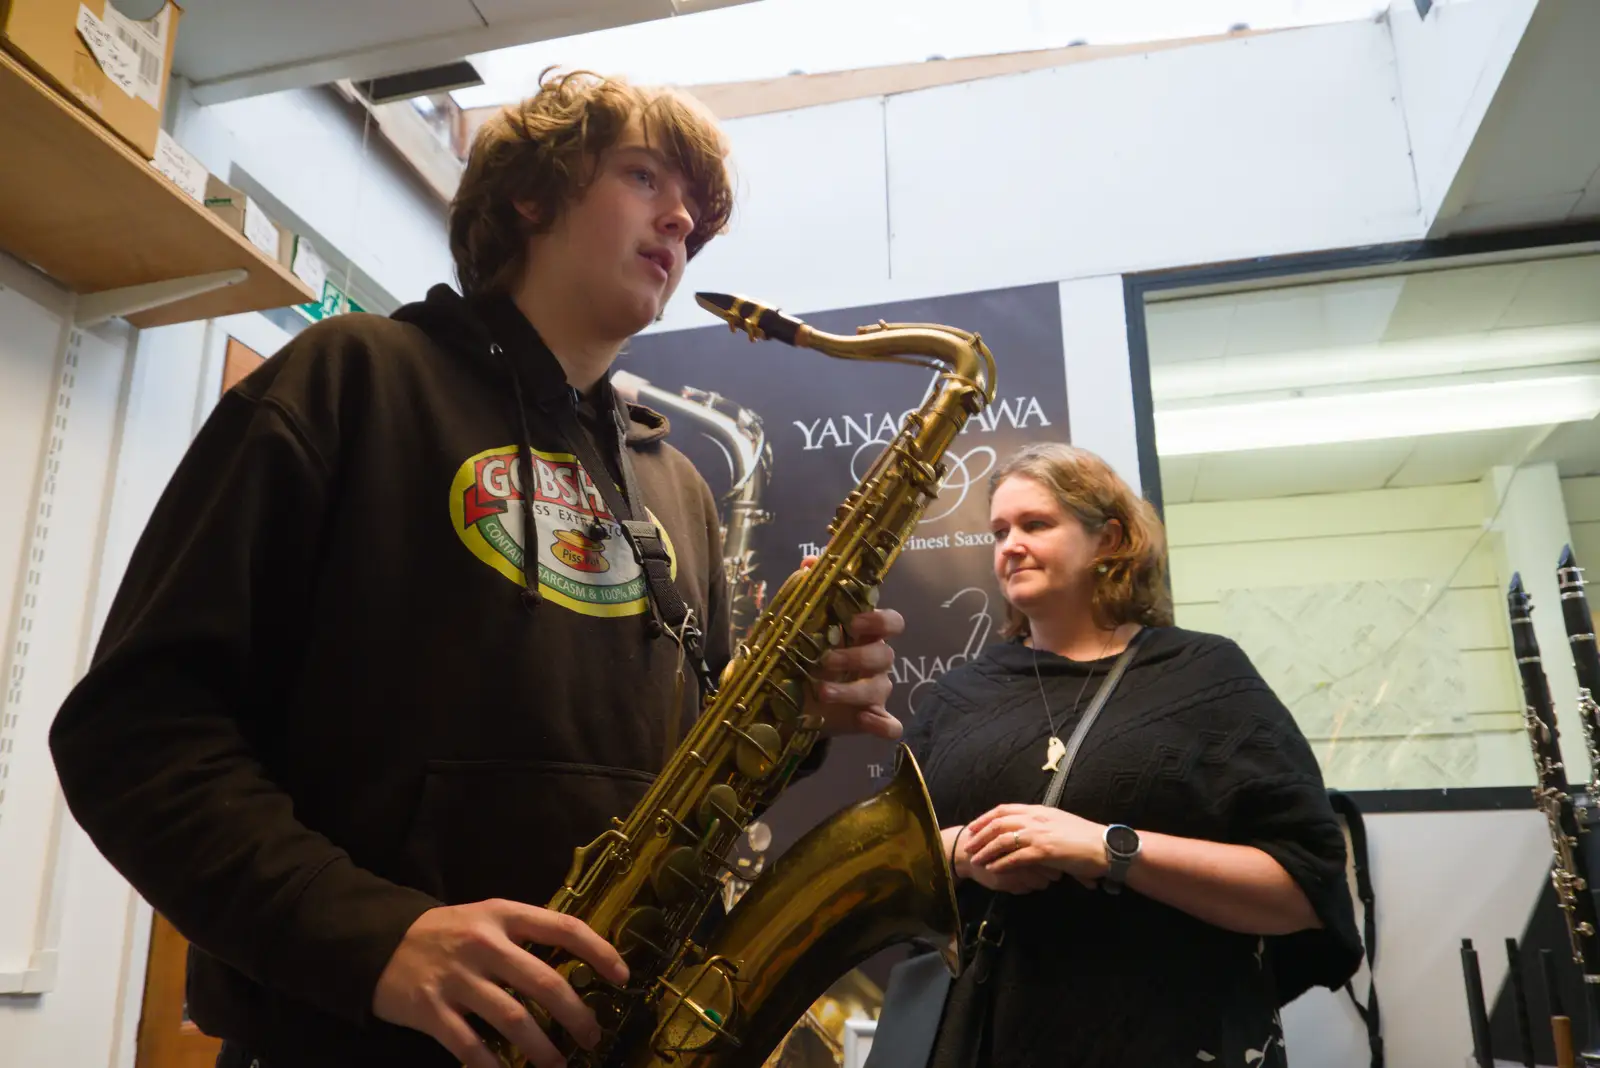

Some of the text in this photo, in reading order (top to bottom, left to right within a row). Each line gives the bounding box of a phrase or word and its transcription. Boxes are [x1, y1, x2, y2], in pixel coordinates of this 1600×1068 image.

[793, 396, 1052, 450] YANAAWA
[482, 459, 612, 518] GOBSH
[562, 548, 582, 565] Piss
[954, 530, 996, 547] Saxo
[485, 522, 525, 568] CONTAIN
[538, 566, 586, 598] SARCASM
[588, 588, 597, 600] &
[600, 588, 628, 601] 100%
[888, 654, 967, 683] ANA
